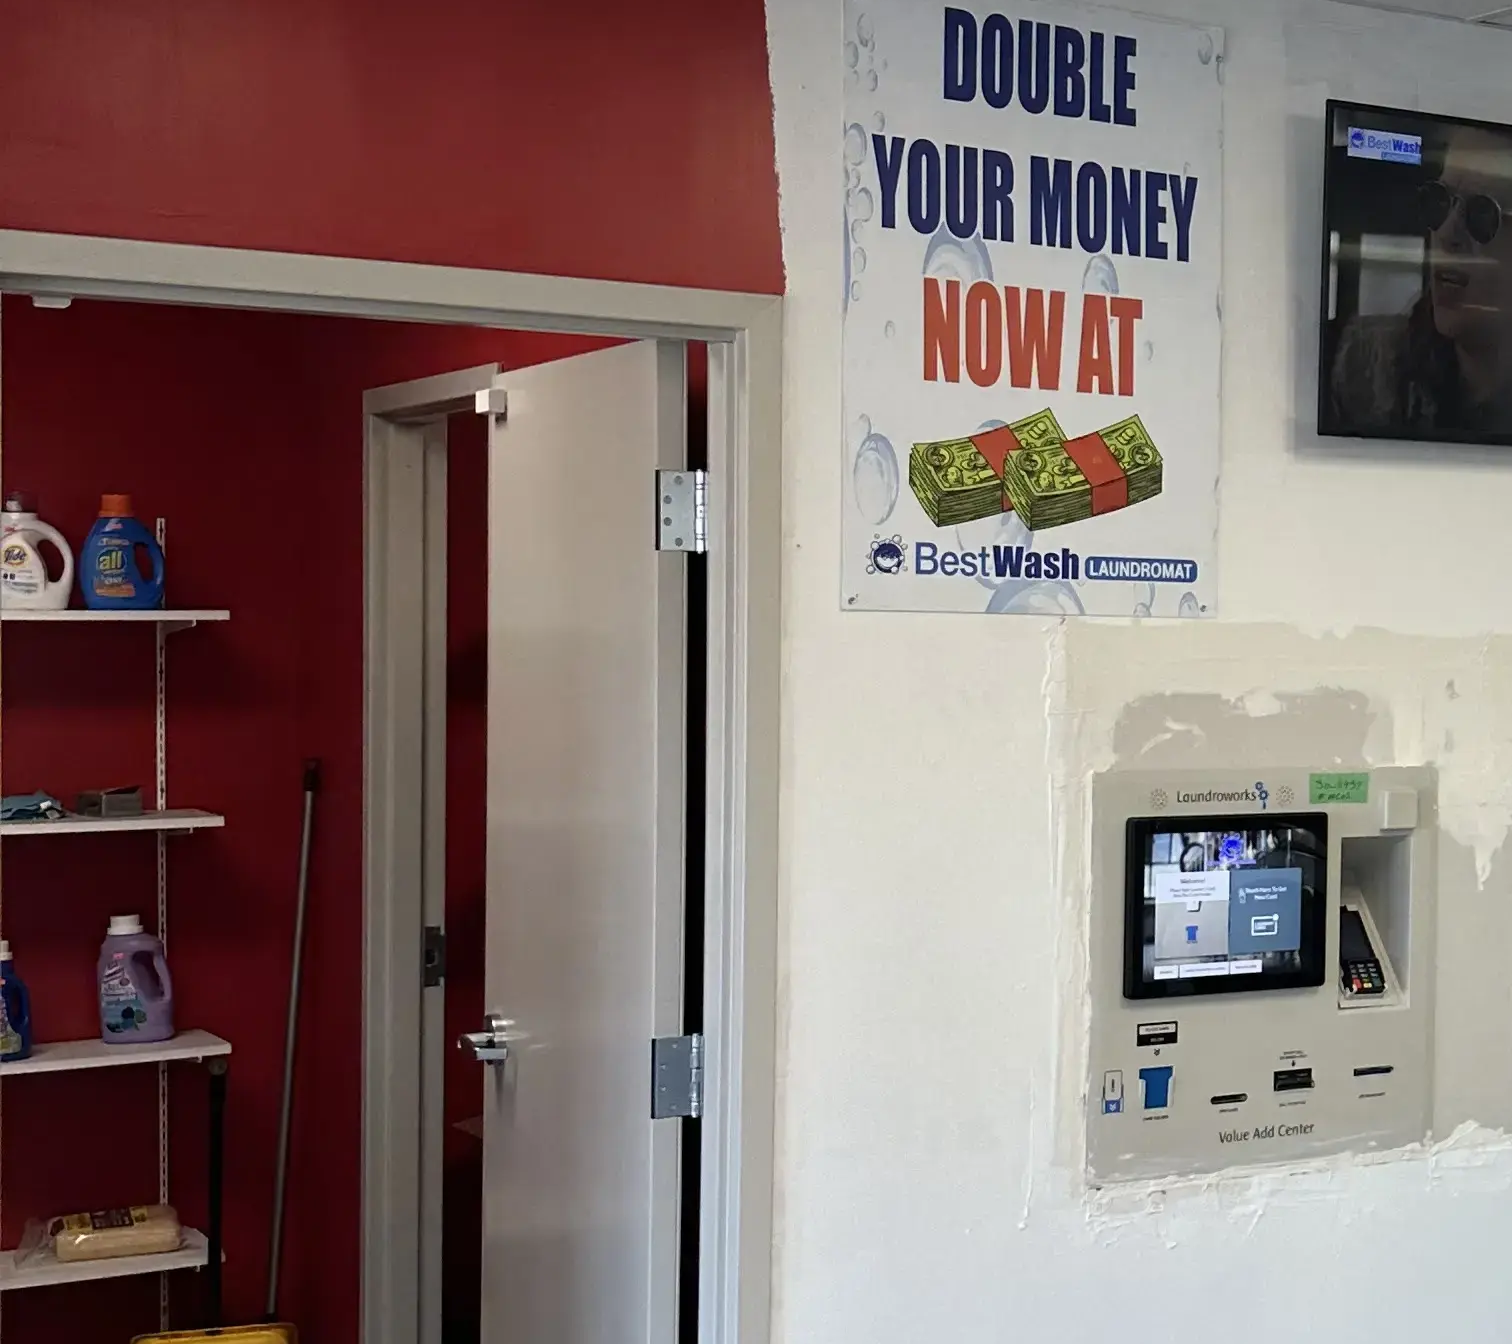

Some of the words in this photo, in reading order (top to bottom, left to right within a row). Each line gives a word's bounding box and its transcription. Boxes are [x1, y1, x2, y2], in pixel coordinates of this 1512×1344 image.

[943, 6, 1137, 127] DOUBLE
[871, 133, 1014, 243] YOUR
[1030, 156, 1197, 263] MONEY
[923, 276, 1066, 390] NOW
[1076, 294, 1143, 397] AT
[99, 551, 122, 570] all
[1089, 560, 1193, 579] LAUNDROMAT
[1177, 788, 1257, 803] Laundroworks
[1219, 1130, 1250, 1144] Value
[1253, 1126, 1275, 1139] Add
[1278, 1123, 1315, 1137] Center
